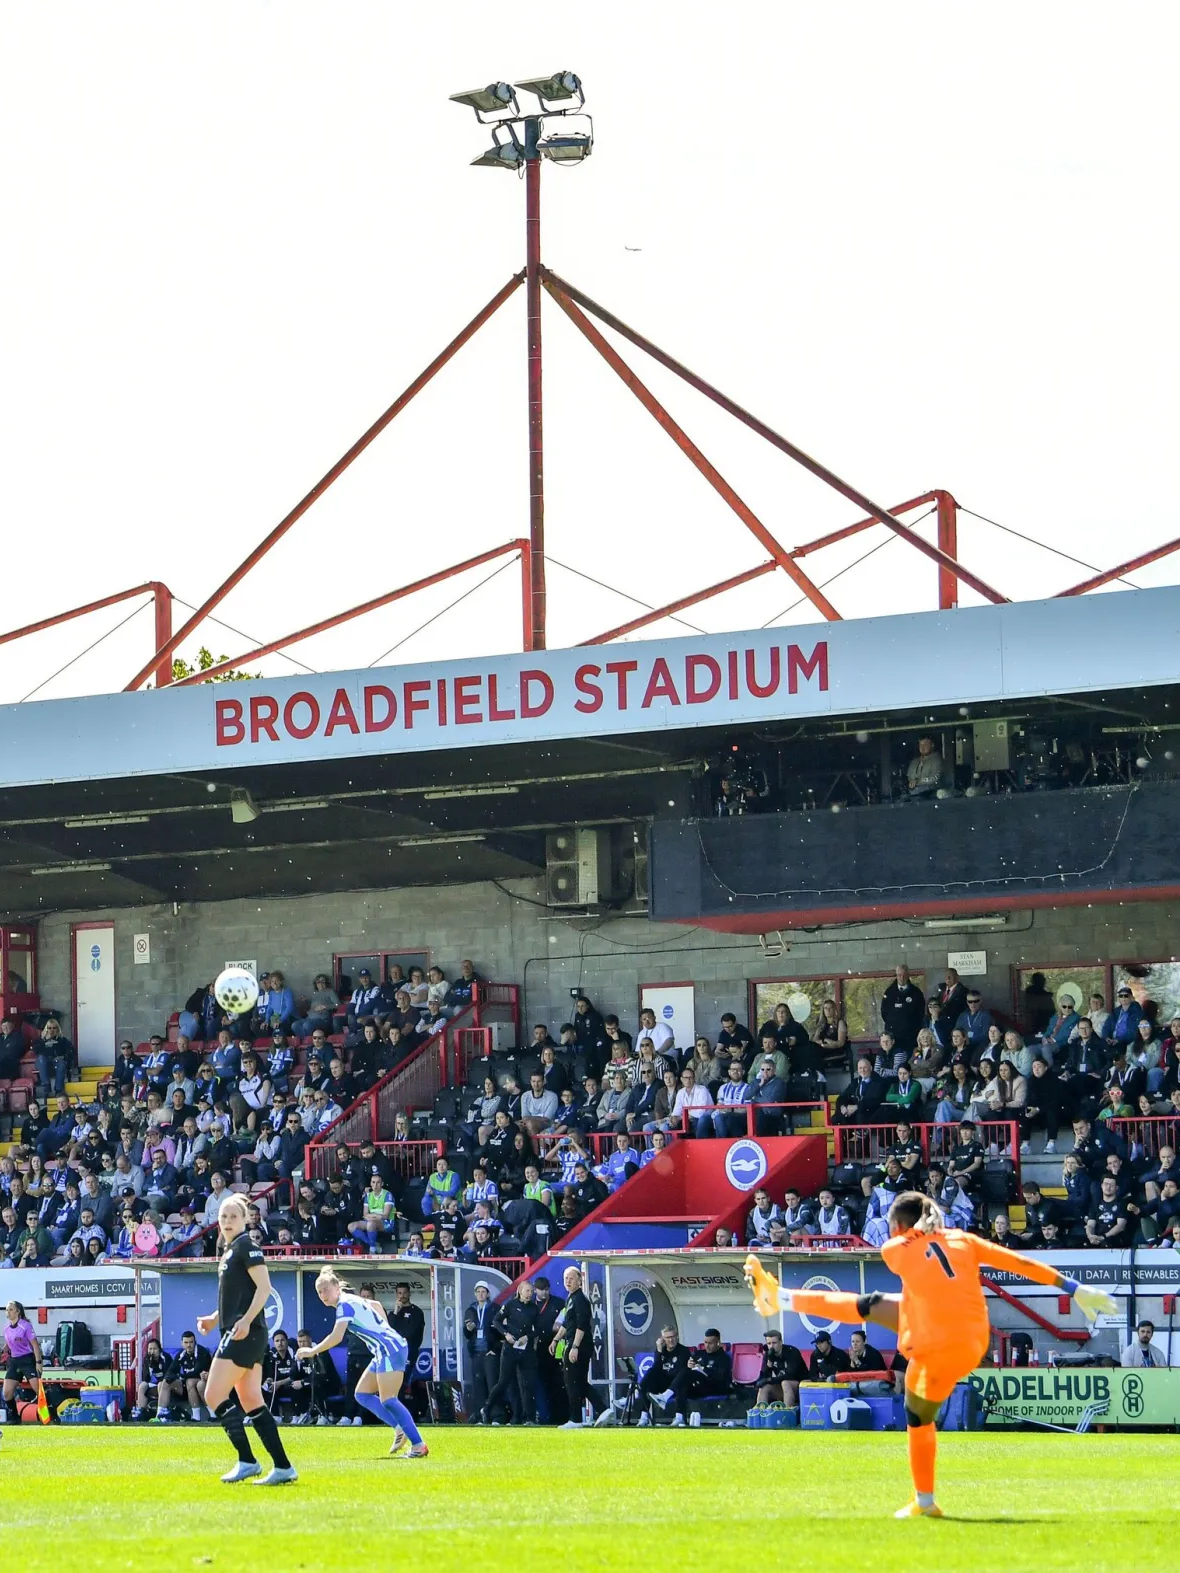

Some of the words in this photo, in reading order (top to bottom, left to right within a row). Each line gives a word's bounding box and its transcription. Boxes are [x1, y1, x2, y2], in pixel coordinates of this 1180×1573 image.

[216, 670, 554, 746] BROADFIELD
[574, 641, 828, 713] STADIUM
[925, 1241, 956, 1279] 1
[671, 1276, 739, 1284] FASTSIGNS
[1086, 1269, 1110, 1279] DATA
[51, 1284, 74, 1294] SMART
[75, 1284, 99, 1293] HOMES
[106, 1283, 126, 1292] CCTV
[443, 1285, 455, 1363] HOME
[591, 1283, 603, 1361] AWAY
[968, 1375, 1110, 1401] PADELHUB
[1128, 1380, 1138, 1393] P
[1021, 1405, 1033, 1416] OF
[1036, 1406, 1074, 1416] INDOOR
[1128, 1397, 1139, 1412] H
